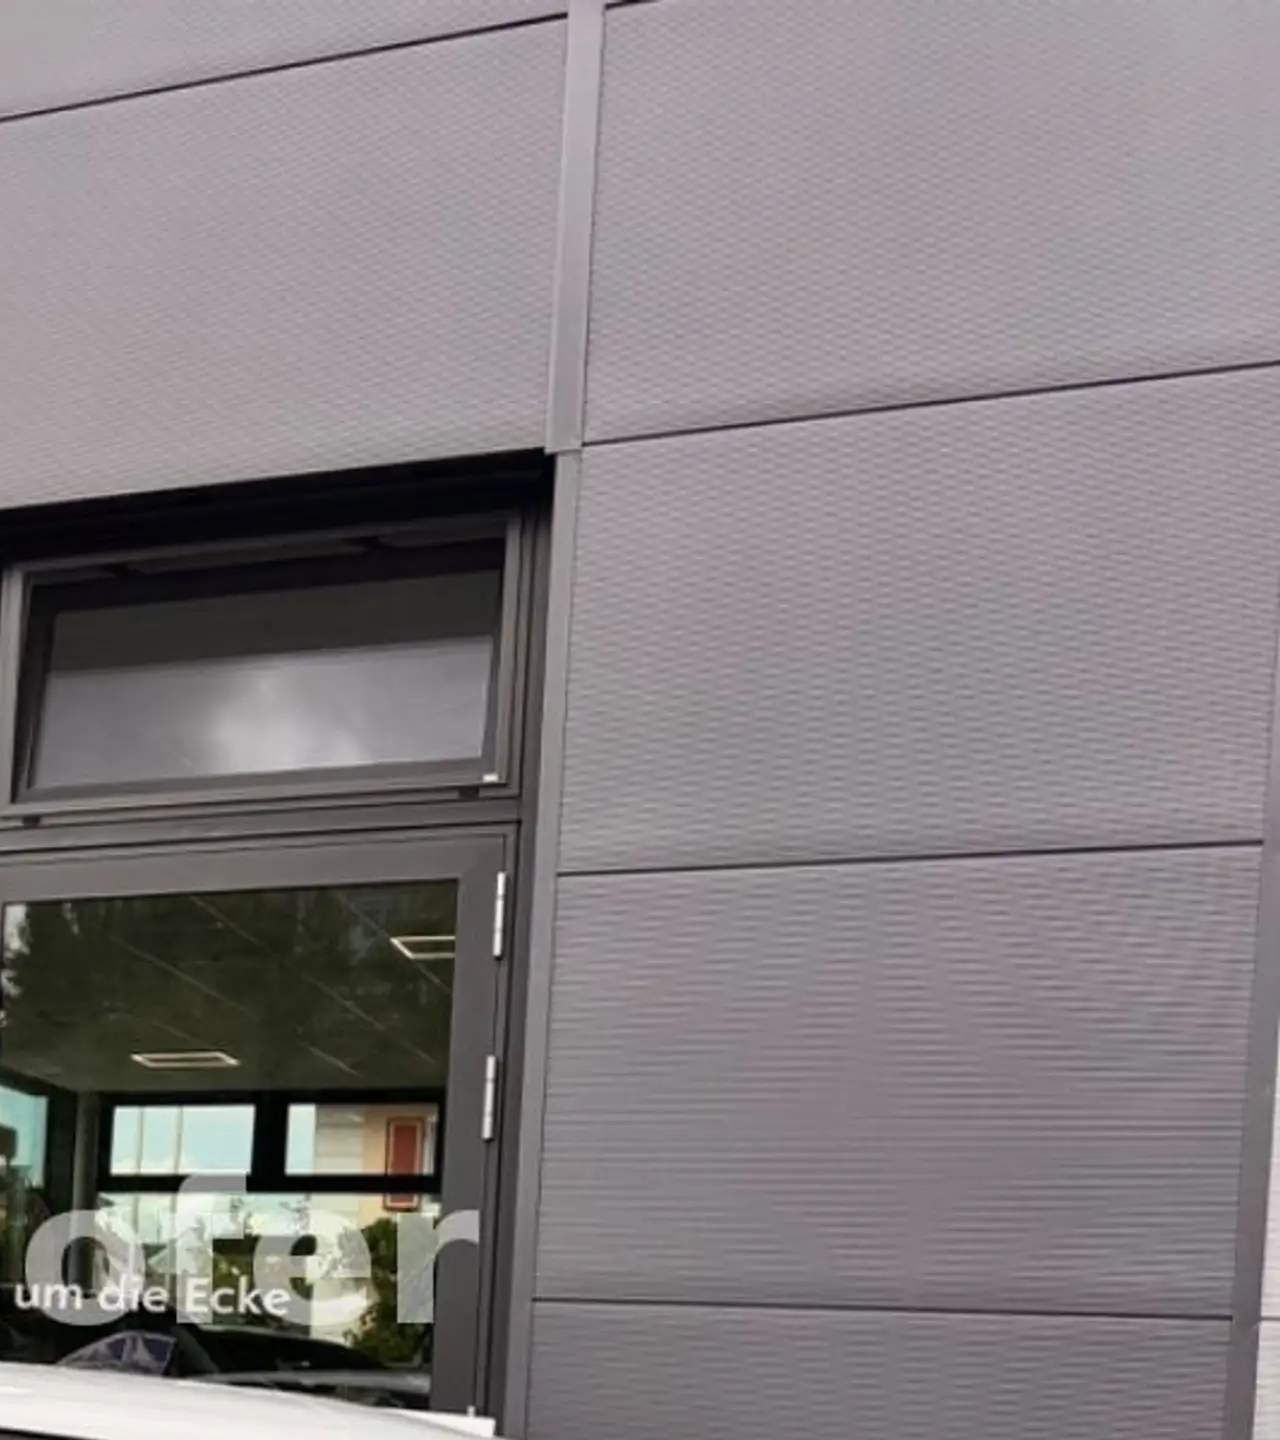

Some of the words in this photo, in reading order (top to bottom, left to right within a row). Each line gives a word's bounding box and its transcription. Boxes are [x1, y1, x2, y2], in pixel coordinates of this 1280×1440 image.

[13, 1277, 82, 1310] um
[97, 1274, 170, 1313] die
[184, 1275, 292, 1316] Ecke
